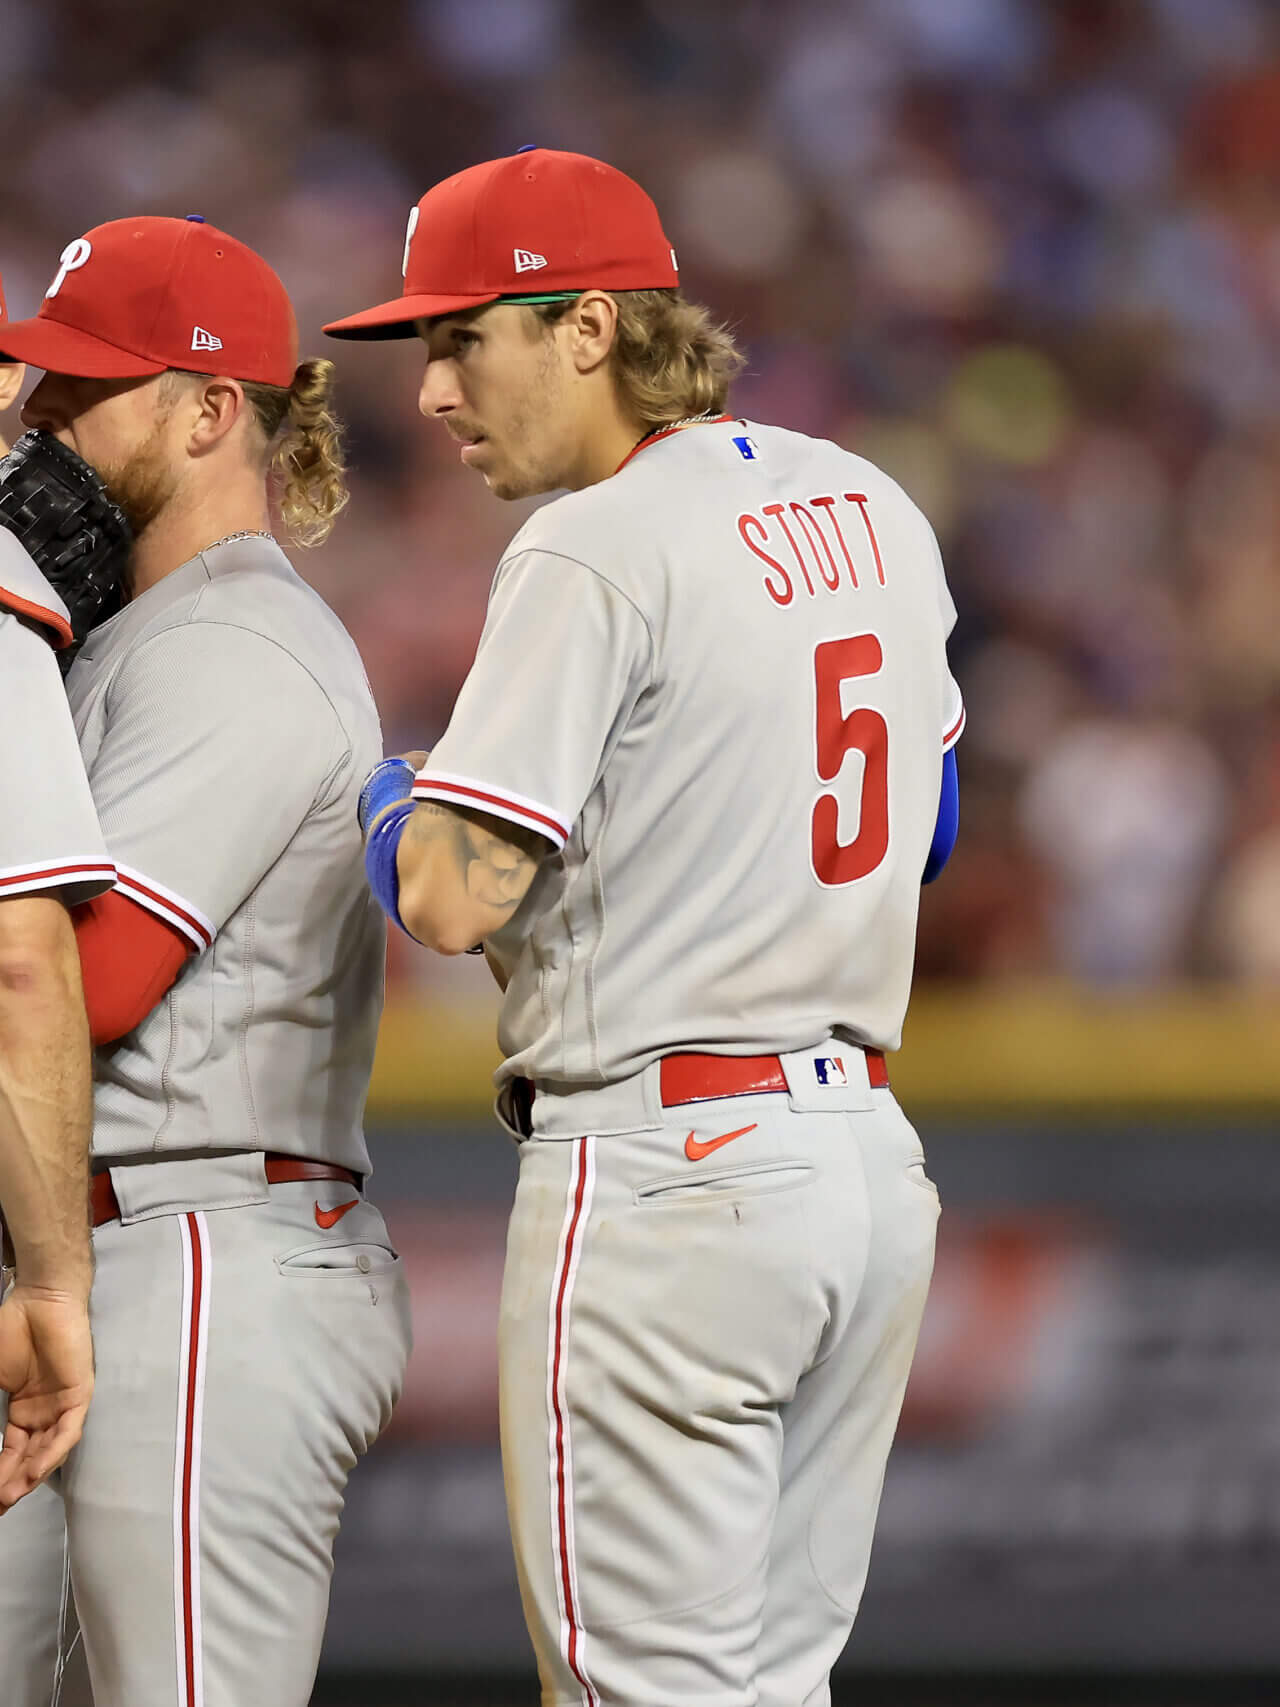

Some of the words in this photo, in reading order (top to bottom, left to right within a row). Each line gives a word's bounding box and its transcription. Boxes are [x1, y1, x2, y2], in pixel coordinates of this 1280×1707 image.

[45, 238, 92, 299] P
[735, 490, 888, 610] STOTT
[810, 630, 890, 890] 5
